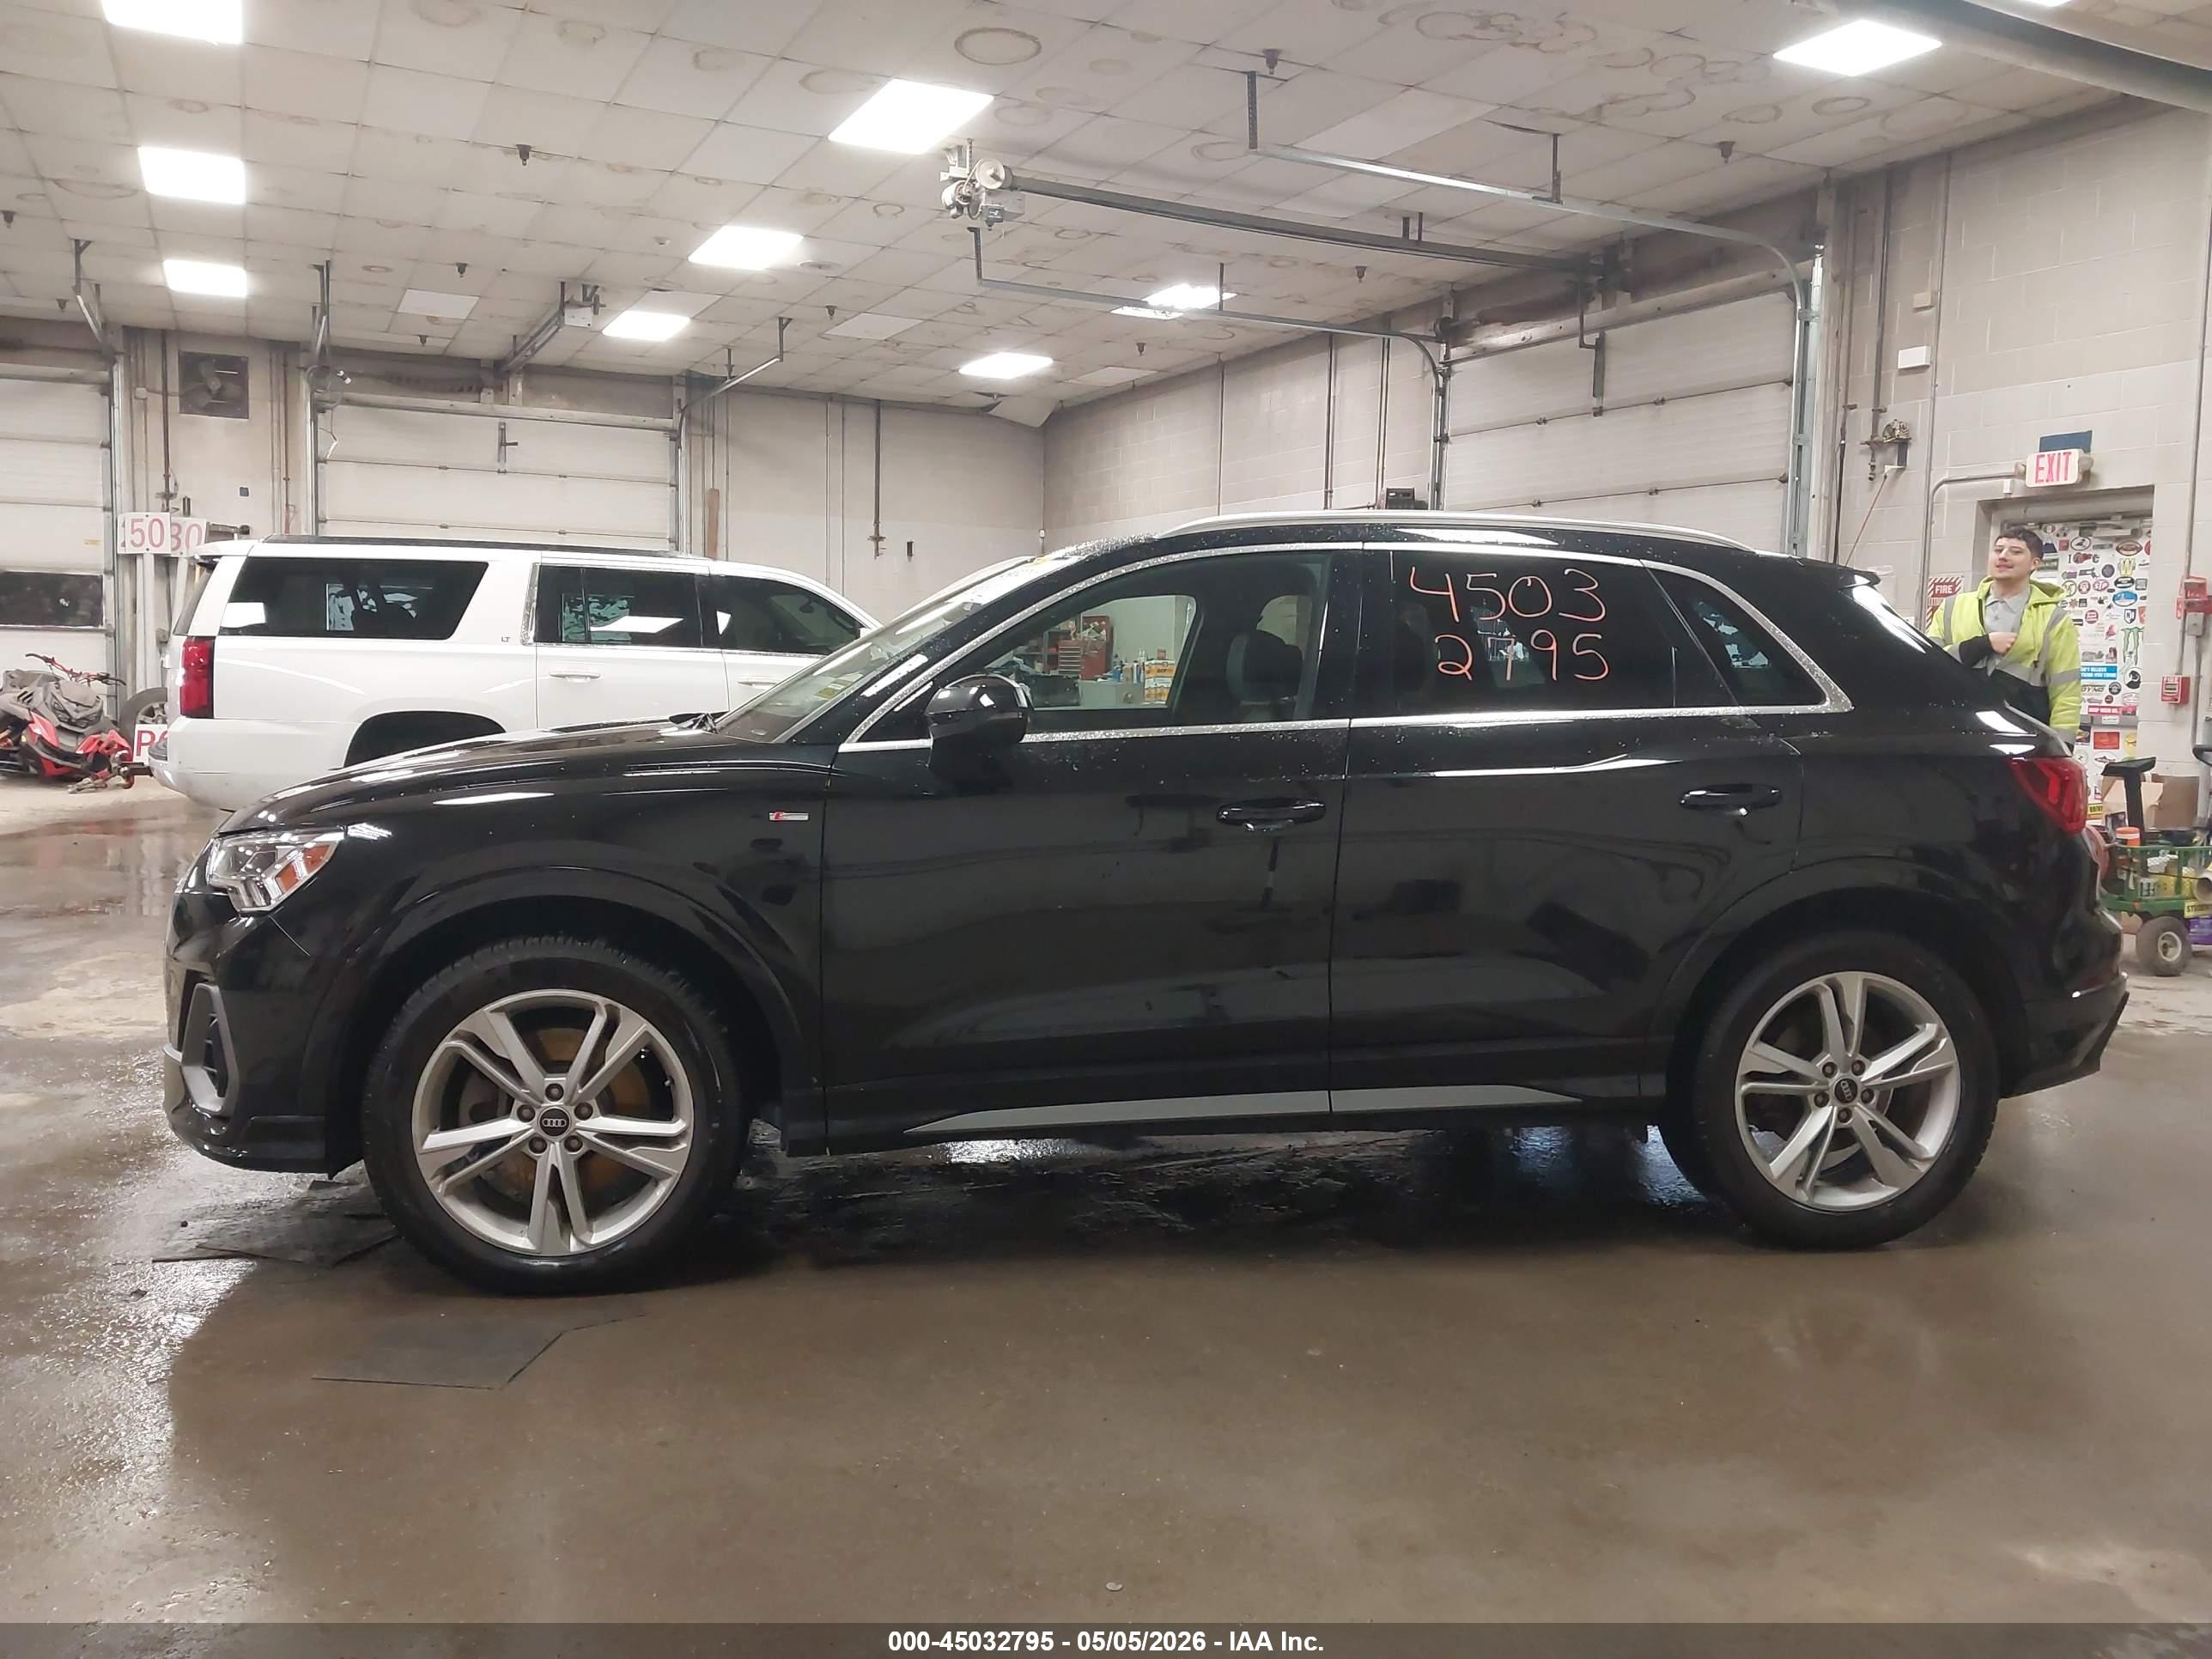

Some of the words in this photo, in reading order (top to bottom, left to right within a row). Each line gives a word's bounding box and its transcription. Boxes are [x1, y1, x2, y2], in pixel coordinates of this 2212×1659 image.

[2035, 452, 2071, 483] EXIT
[131, 518, 165, 548] 50
[171, 522, 203, 551] 30
[1409, 566, 1607, 623] 4503
[1935, 585, 1954, 594] FIRE
[2094, 582, 2108, 592] STP
[1434, 629, 1609, 681] 2795
